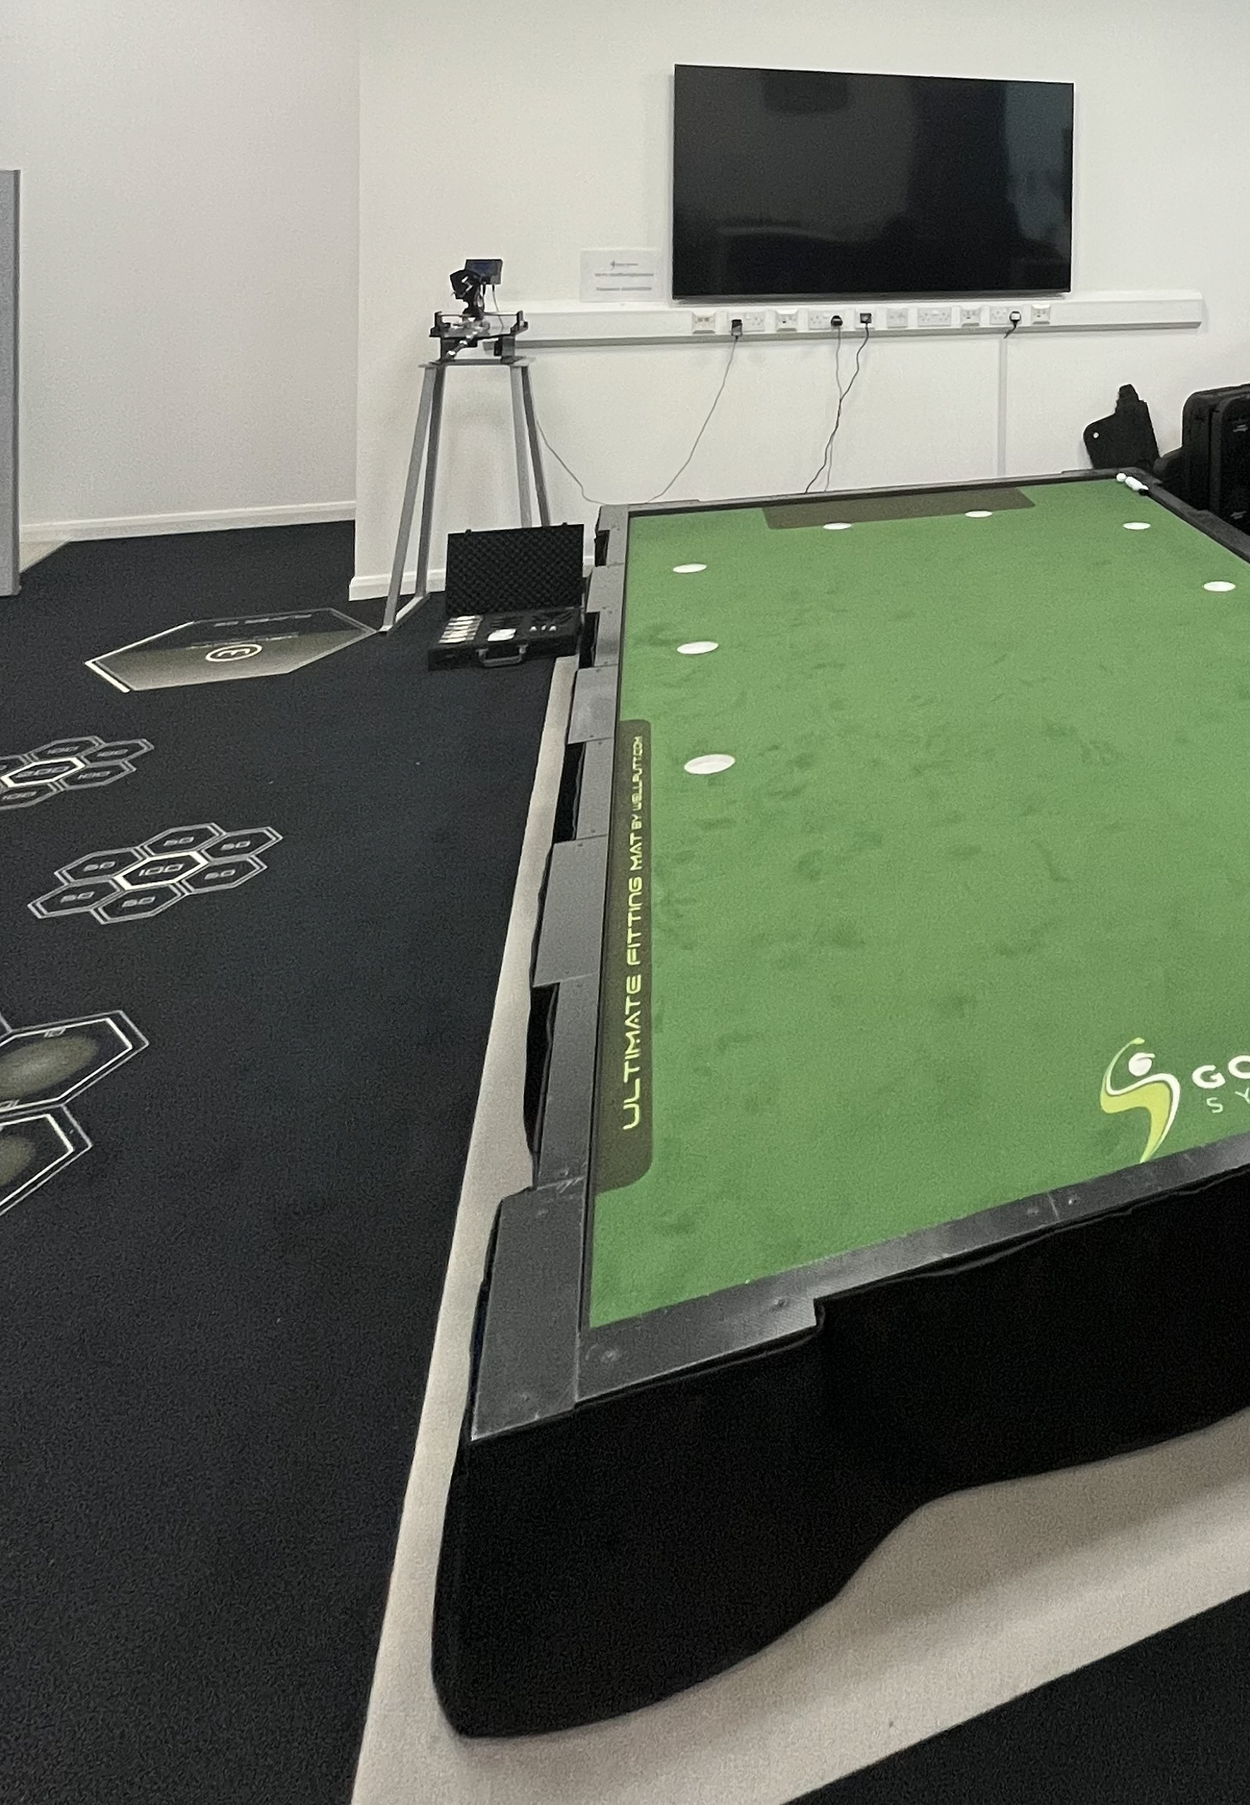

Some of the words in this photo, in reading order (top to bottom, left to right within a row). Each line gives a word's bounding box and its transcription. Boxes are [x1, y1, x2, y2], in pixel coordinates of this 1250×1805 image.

[631, 735, 643, 811] WELLPUTT.COM
[631, 813, 642, 830] BY
[138, 863, 184, 877] 100
[629, 833, 642, 871] MAT
[626, 876, 642, 967] FITTING
[623, 974, 642, 1130] ULTIMATE
